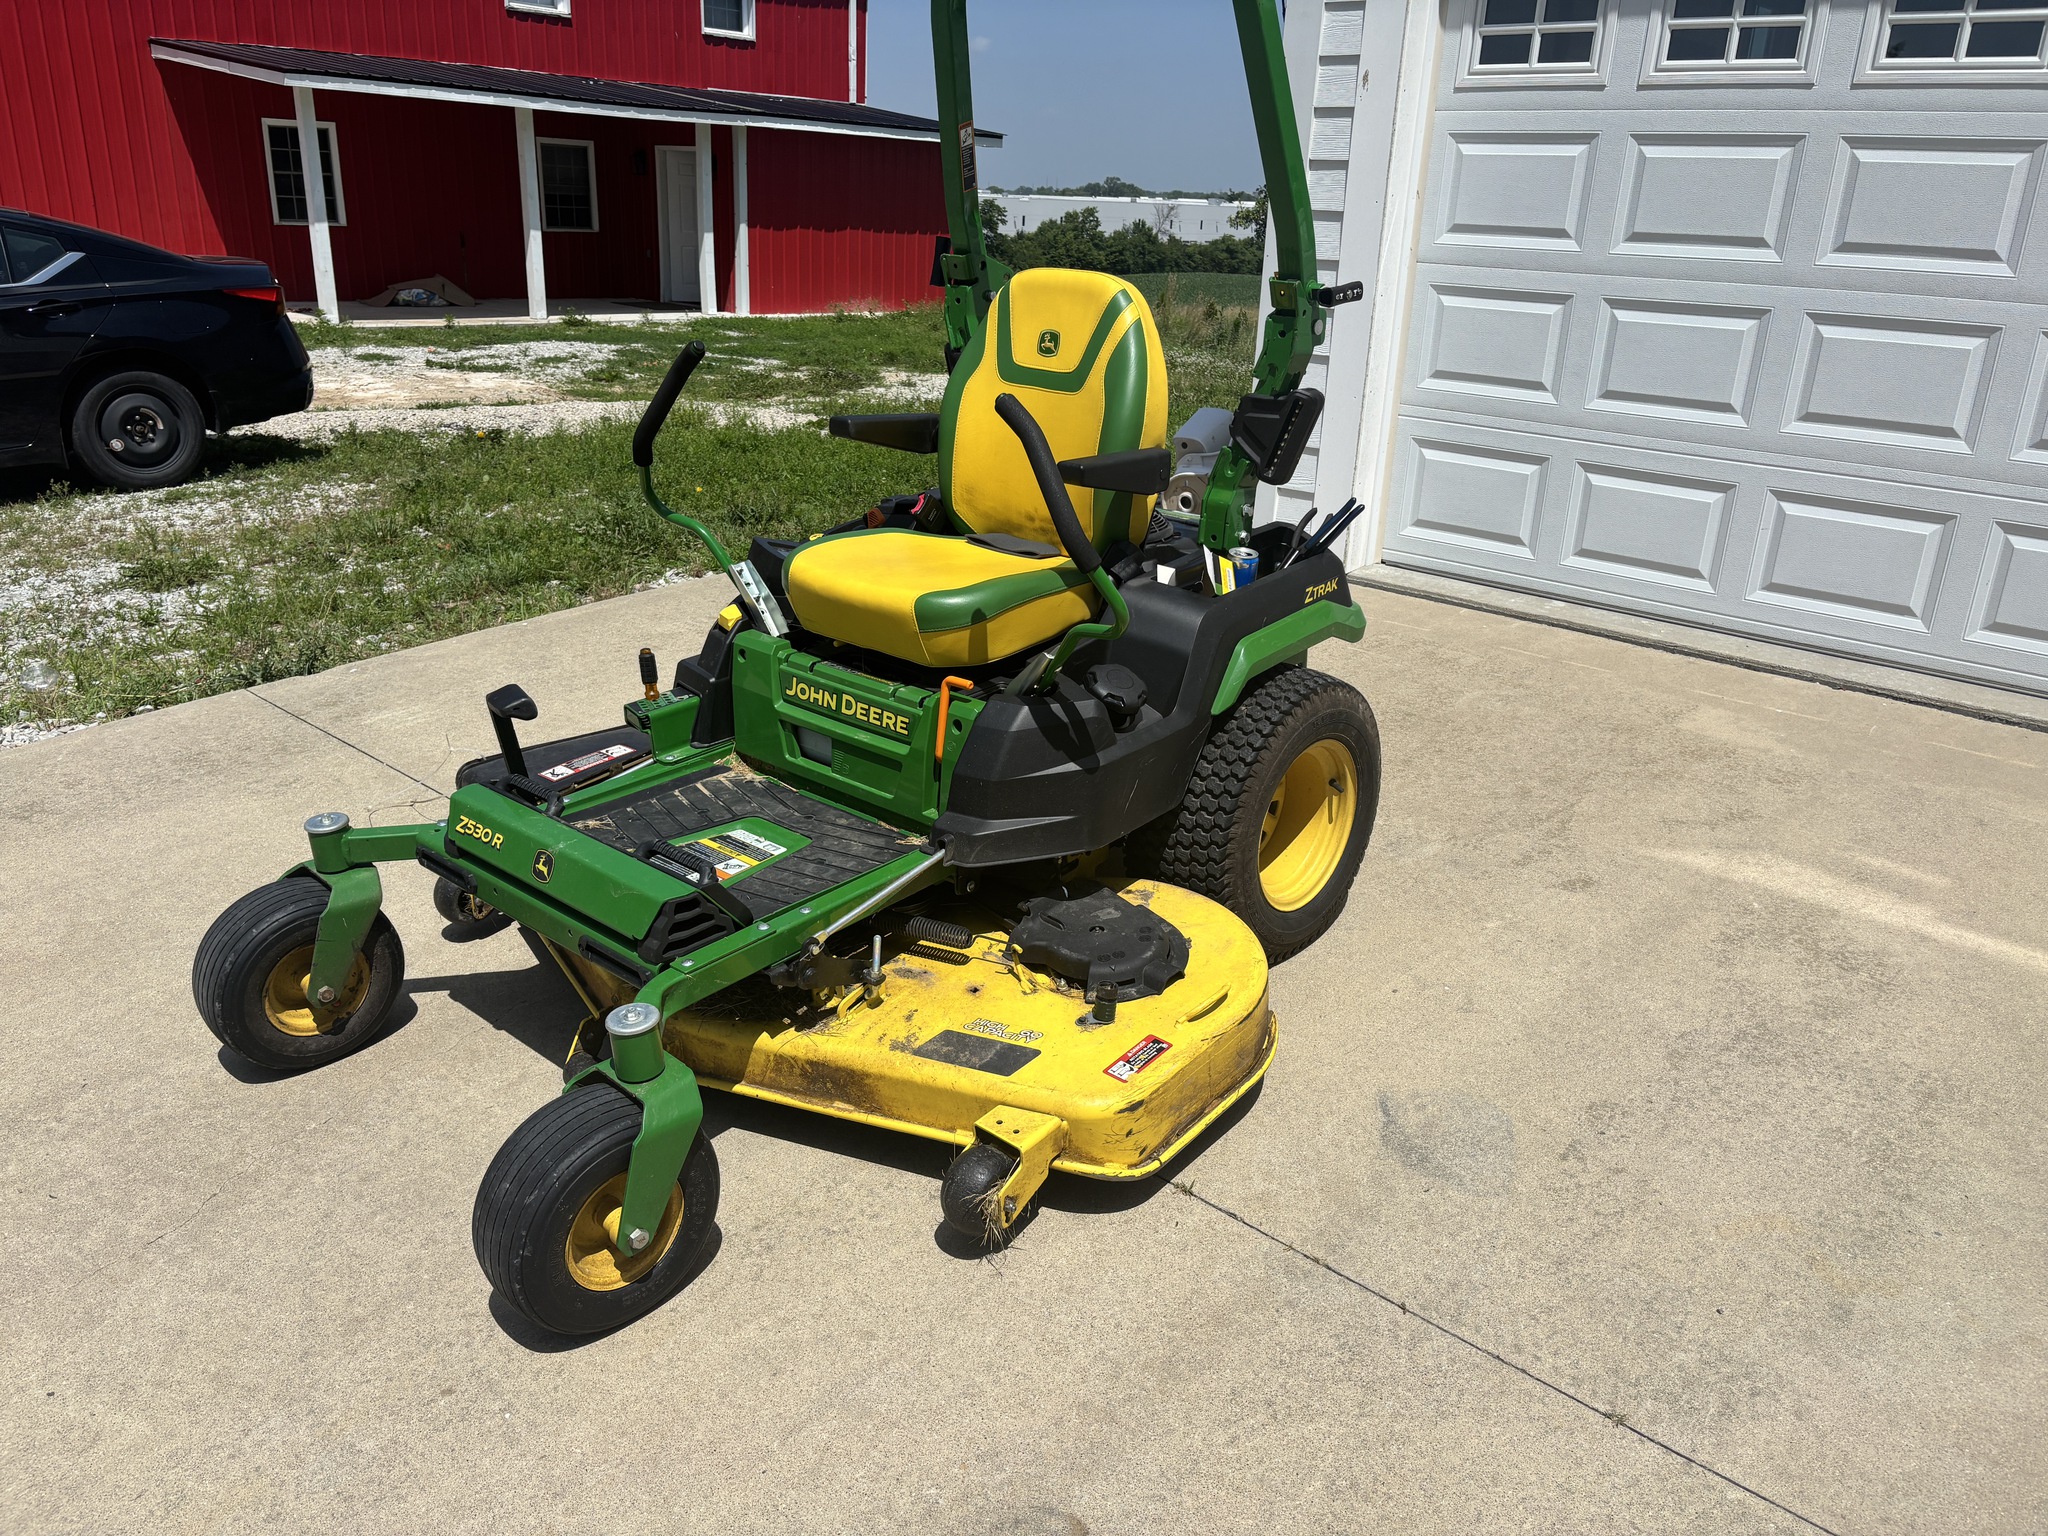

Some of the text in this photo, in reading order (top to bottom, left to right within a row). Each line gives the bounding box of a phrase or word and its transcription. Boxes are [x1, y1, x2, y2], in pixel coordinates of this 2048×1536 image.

[1304, 578, 1339, 604] ZTRAK
[786, 677, 910, 735] JOHN DEERE
[963, 1023, 1036, 1044] CAPACITY
[971, 1017, 1010, 1031] HIGH
